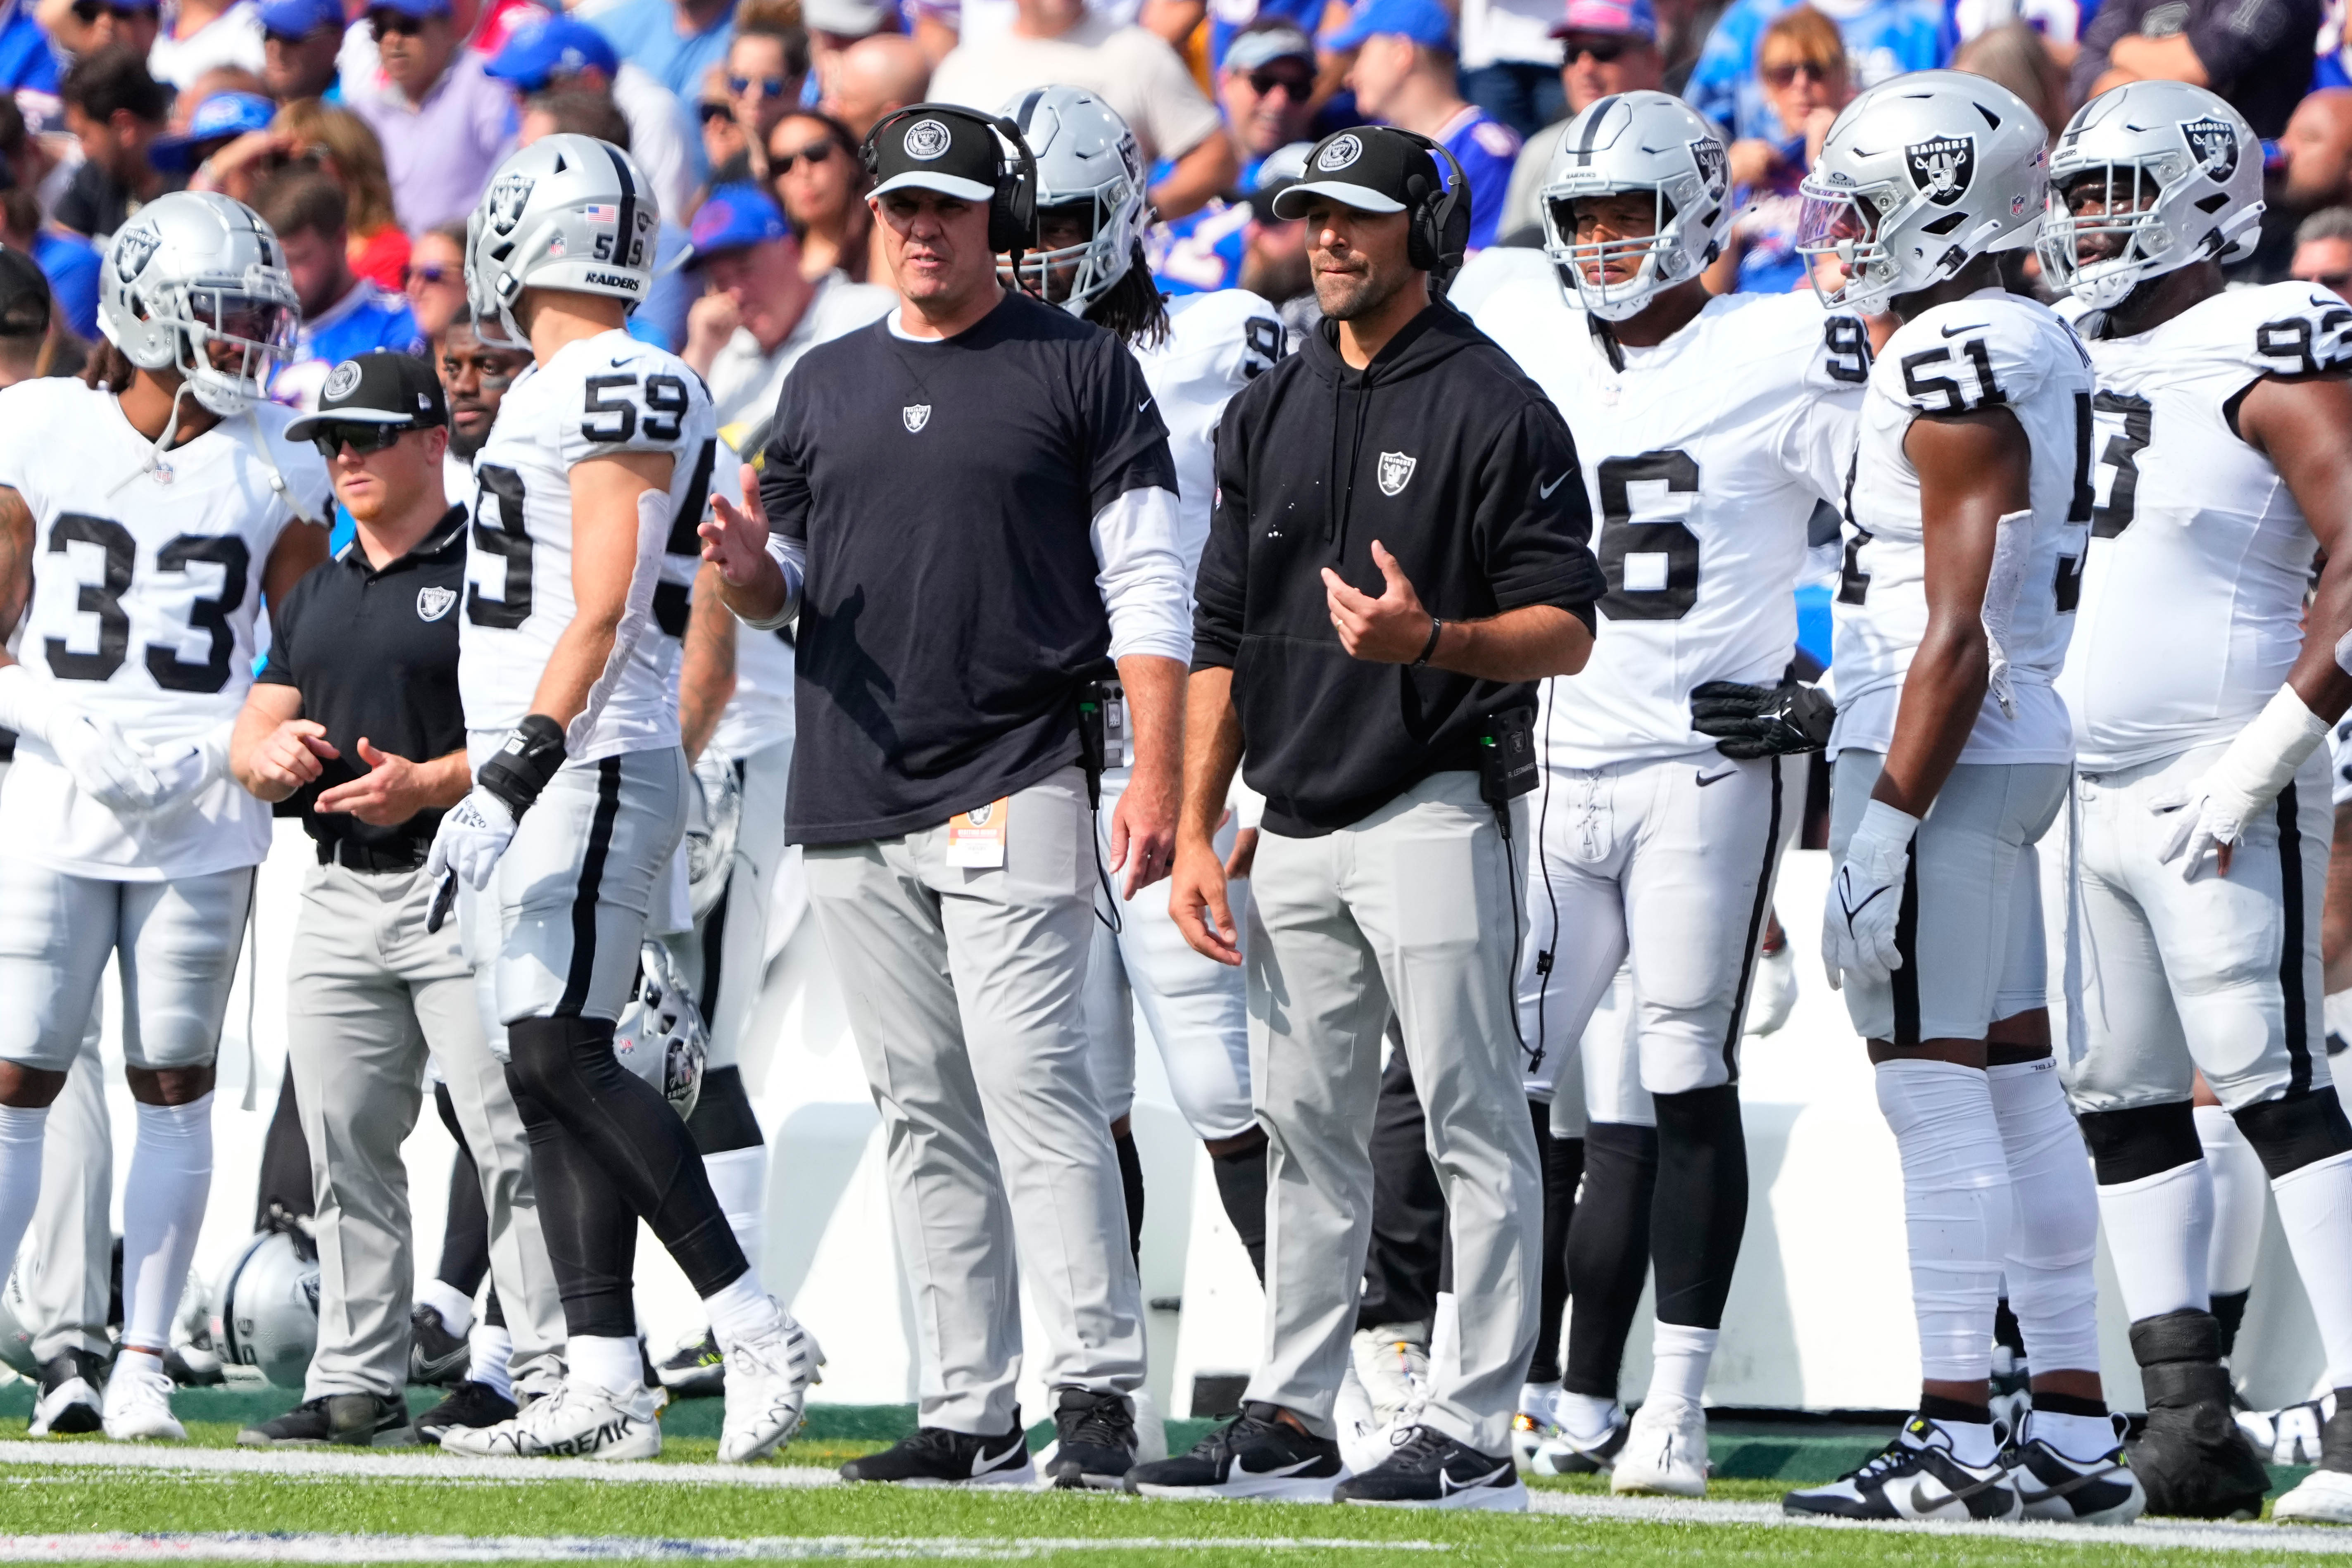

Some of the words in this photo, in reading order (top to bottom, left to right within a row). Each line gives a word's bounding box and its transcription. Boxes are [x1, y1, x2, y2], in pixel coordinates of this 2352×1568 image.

[1910, 138, 1968, 155] RAIDERS
[2187, 123, 2231, 132] RAIDERS
[584, 270, 640, 291] RAIDERS
[1244, 316, 1288, 379] 9
[1824, 315, 1874, 383] 9
[1901, 339, 2008, 412] 51
[580, 373, 689, 442] 59
[1596, 449, 1700, 620] 6
[44, 512, 251, 694] 33
